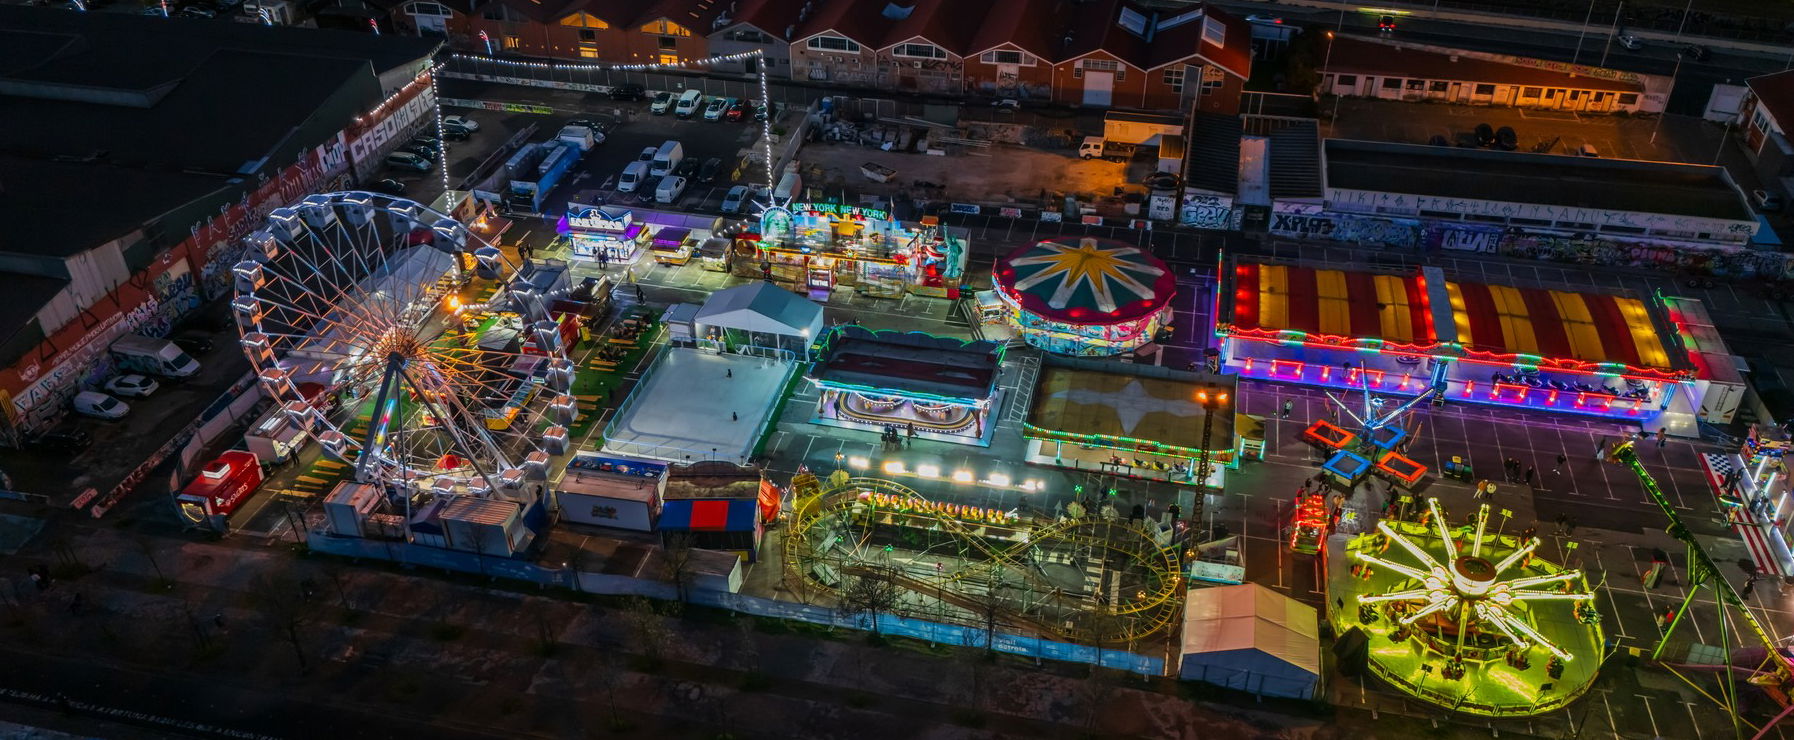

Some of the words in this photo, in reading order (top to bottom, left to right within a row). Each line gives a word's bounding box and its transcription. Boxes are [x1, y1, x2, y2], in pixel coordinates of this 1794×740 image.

[792, 203, 811, 212] NEW
[813, 204, 837, 214] YORK
[840, 206, 859, 215] NEW
[861, 208, 885, 220] YORK
